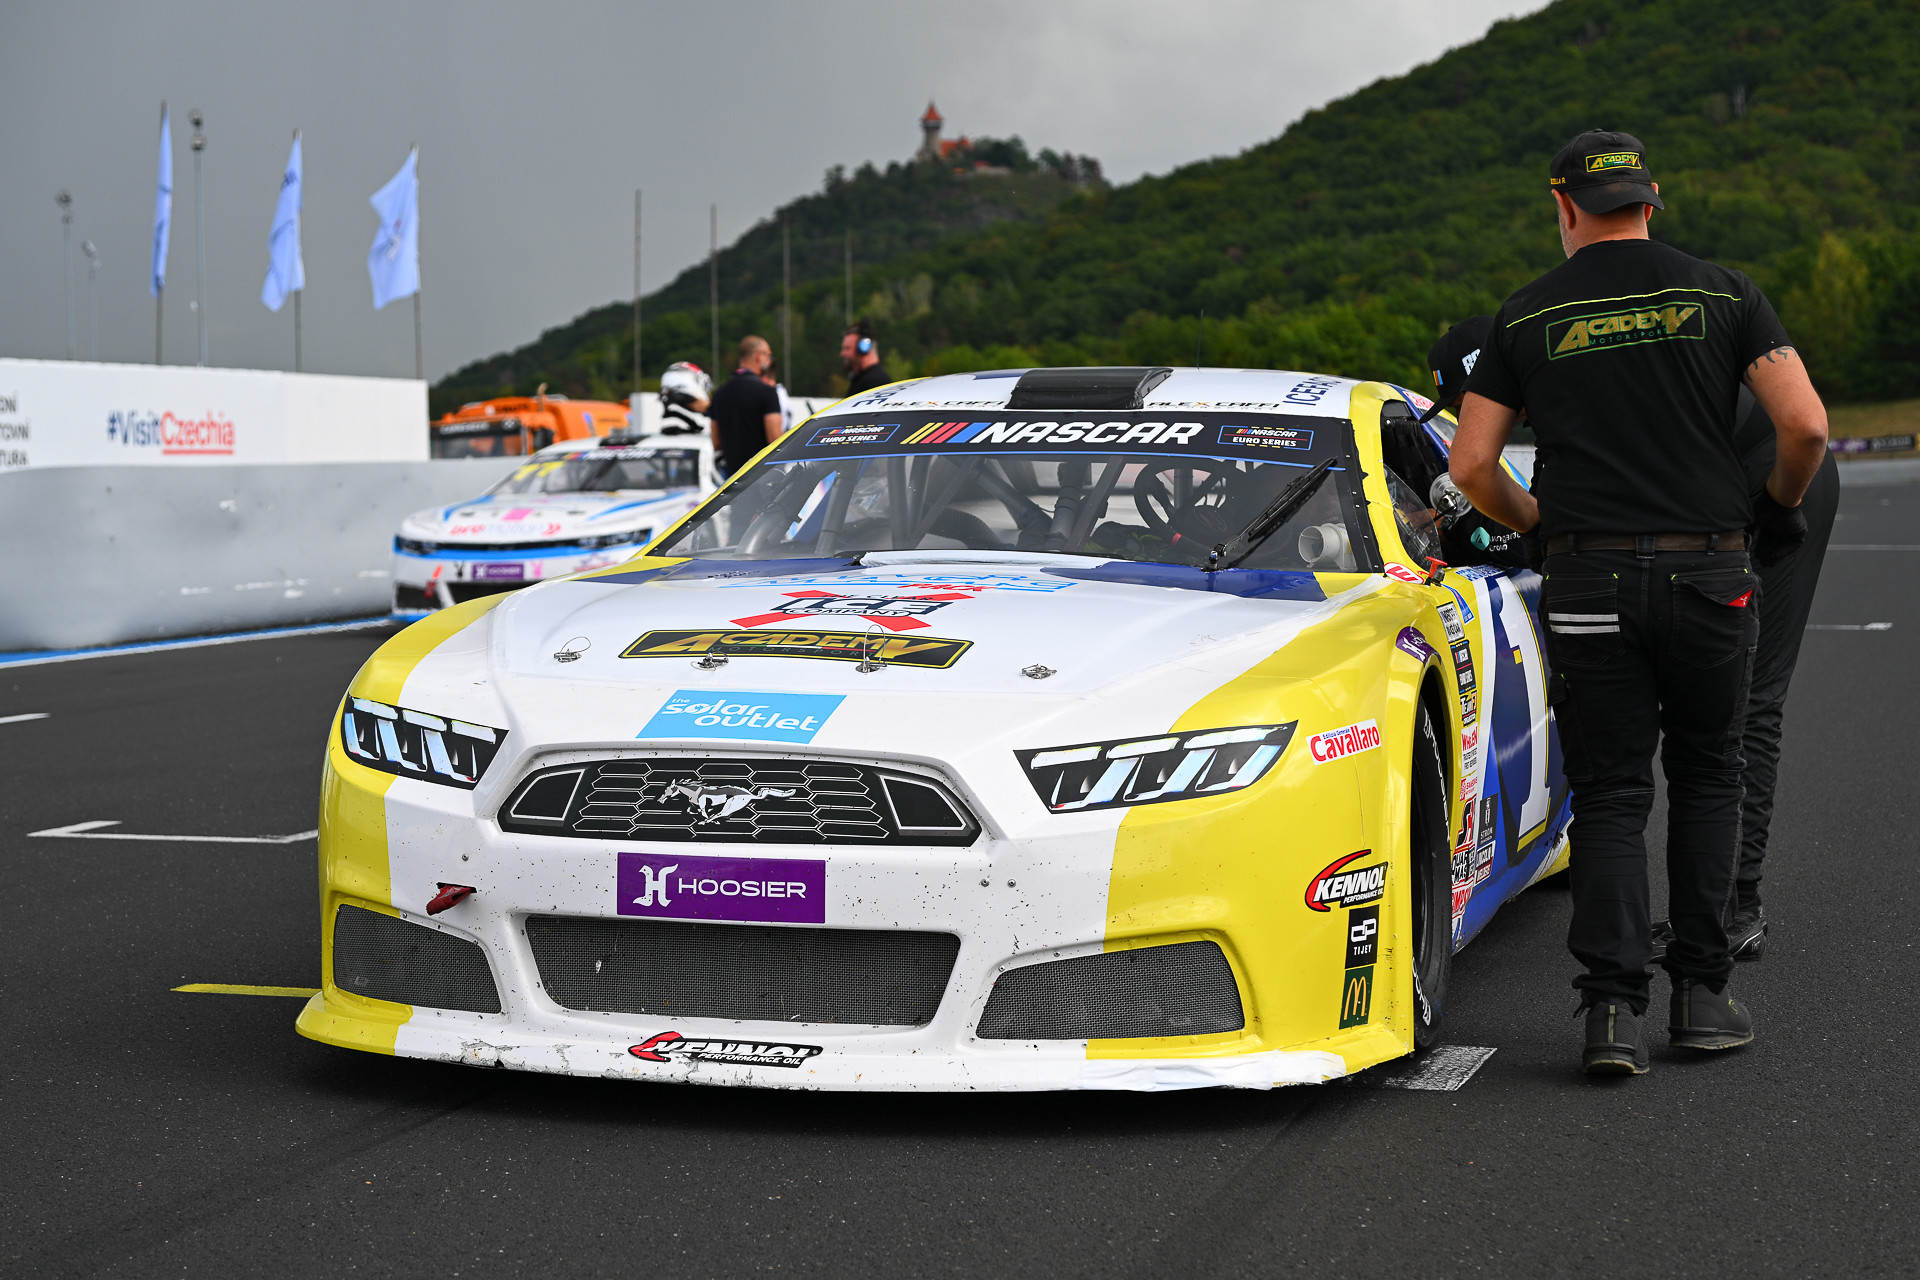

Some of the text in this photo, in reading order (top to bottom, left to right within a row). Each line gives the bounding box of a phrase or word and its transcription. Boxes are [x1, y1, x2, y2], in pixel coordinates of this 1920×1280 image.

[1590, 154, 1639, 169] ACADEMY
[1553, 306, 1699, 354] ACADEMY
[107, 410, 235, 446] #VisitCzechia
[841, 426, 884, 434] NASCAR
[969, 421, 1204, 445] NASCAR
[1250, 428, 1298, 438] NASCAR
[847, 434, 879, 442] SERIES
[1232, 437, 1297, 447] EURO SERIES
[772, 598, 952, 614] ICE
[789, 608, 905, 616] COMPANY
[640, 633, 953, 659] ACADEMY
[661, 699, 770, 715] solar
[671, 697, 691, 705] the
[694, 712, 818, 732] outlet
[1310, 725, 1380, 762] Cavallaro
[678, 877, 807, 899] HOOSIER
[1313, 865, 1385, 902] KENNOL
[1343, 890, 1378, 903] PERFORMANCE
[640, 1041, 813, 1058] KENNOL
[698, 1052, 802, 1065] PERFORMANCE OIL
